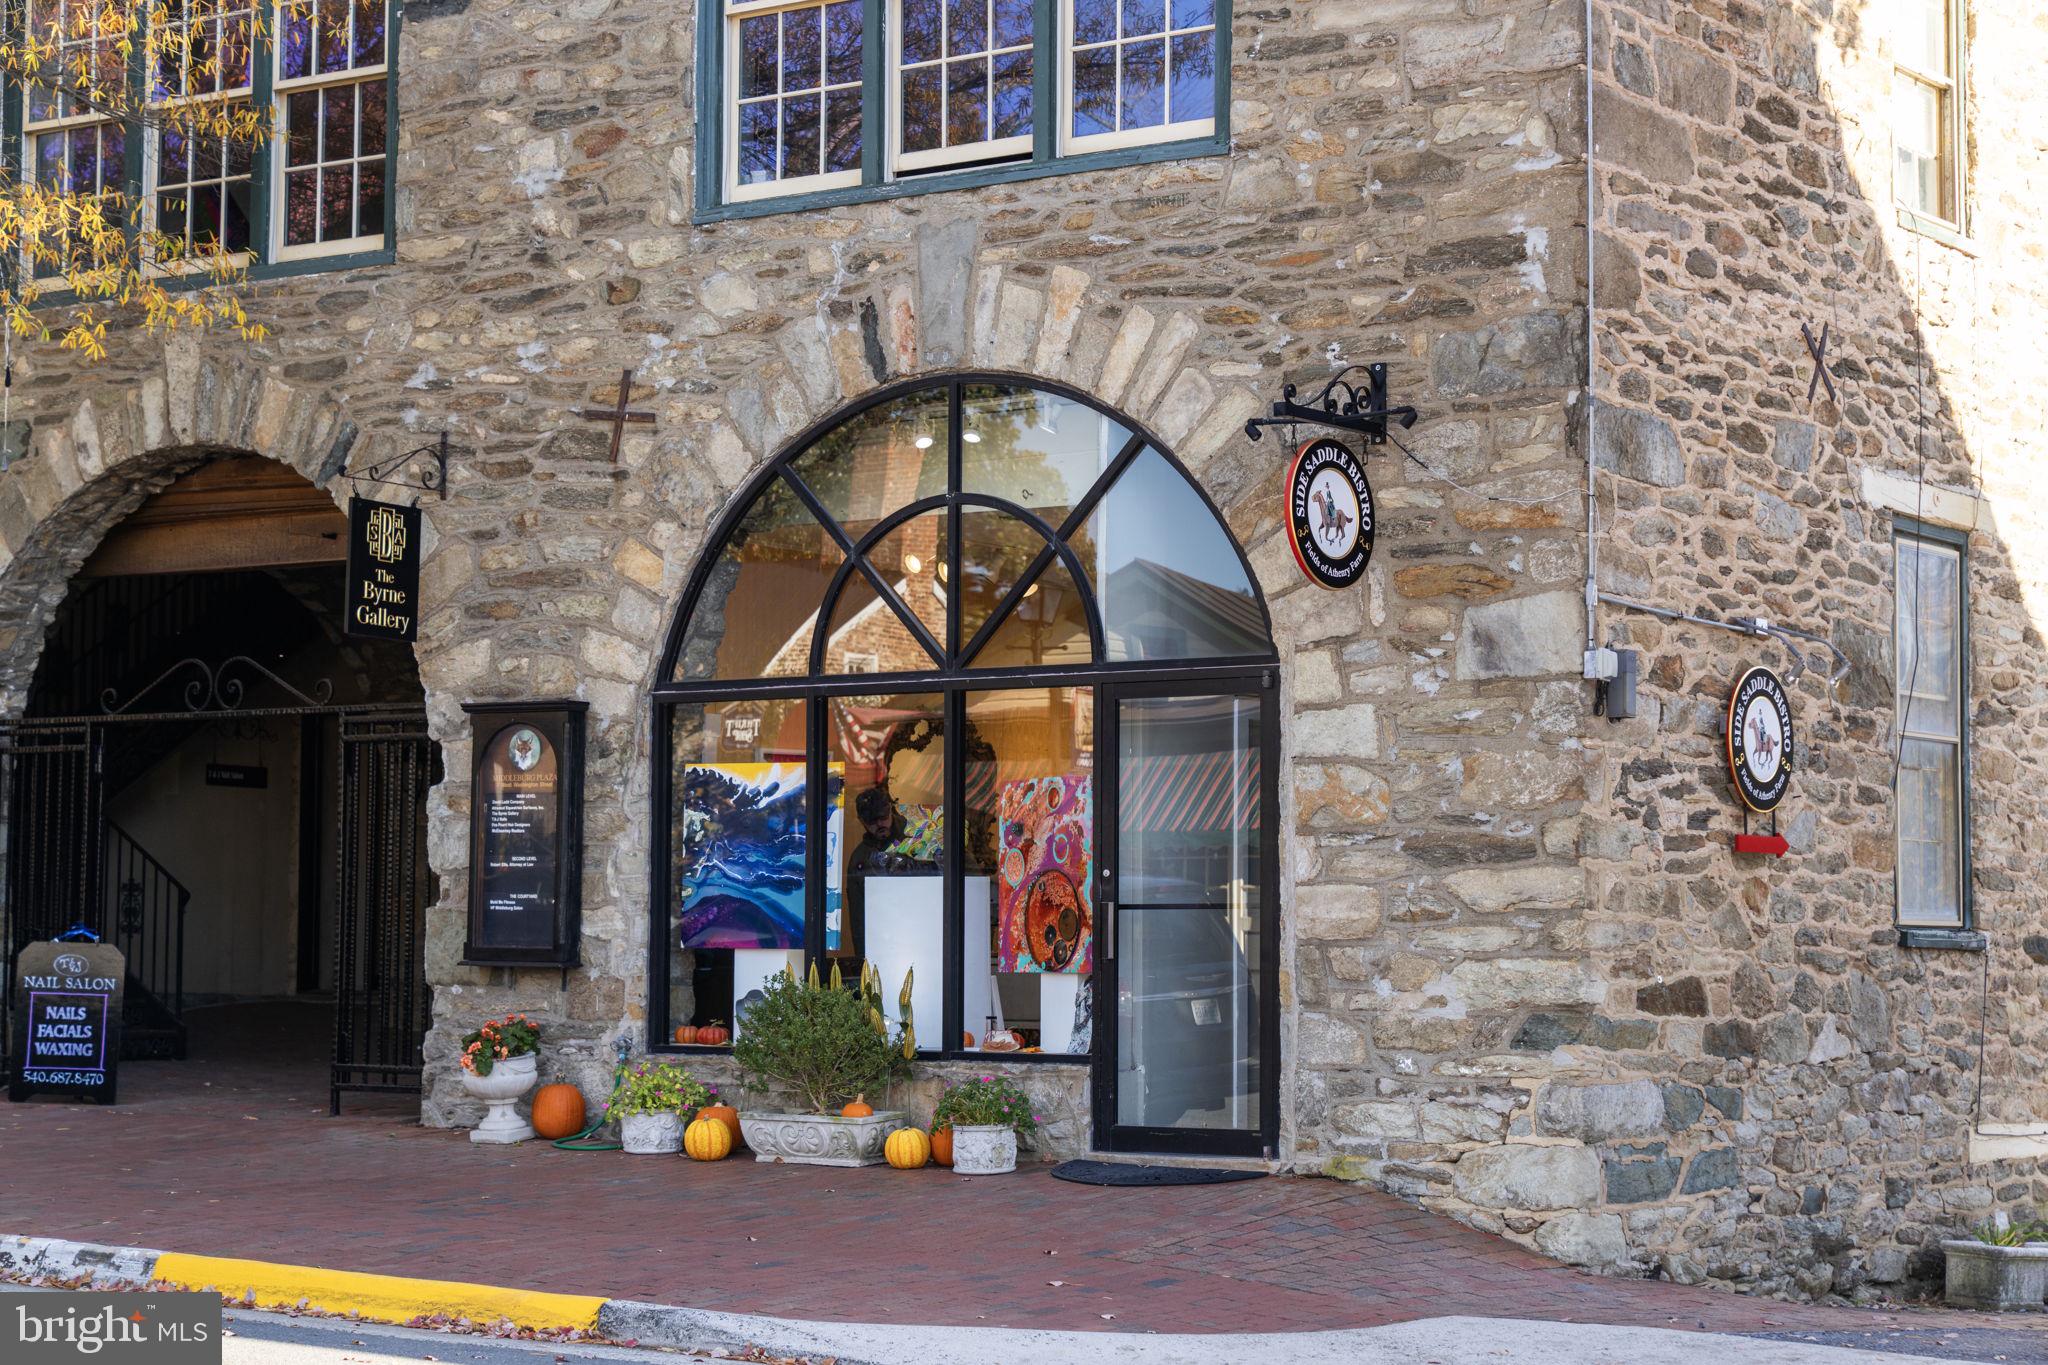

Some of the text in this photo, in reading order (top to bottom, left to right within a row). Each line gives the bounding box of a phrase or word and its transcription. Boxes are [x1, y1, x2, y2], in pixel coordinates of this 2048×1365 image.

[1296, 446, 1371, 531] SIDE SADDLE BISTRO
[1304, 541, 1364, 578] Fields of Athenry Farm
[375, 568, 395, 584] The
[363, 580, 406, 606] Byrne
[356, 605, 410, 634] Gallery
[1734, 676, 1791, 752] SIDE SADDLE BISTRO
[537, 773, 557, 781] PLAZA
[1741, 768, 1753, 793] Fields
[1775, 772, 1786, 793] Farm
[23, 976, 116, 990] NAIL SALON
[45, 1006, 87, 1021] NAILS
[36, 1024, 93, 1039] FACIALS
[34, 1042, 93, 1057] WAXING
[23, 1071, 104, 1086] 540.687.8470
